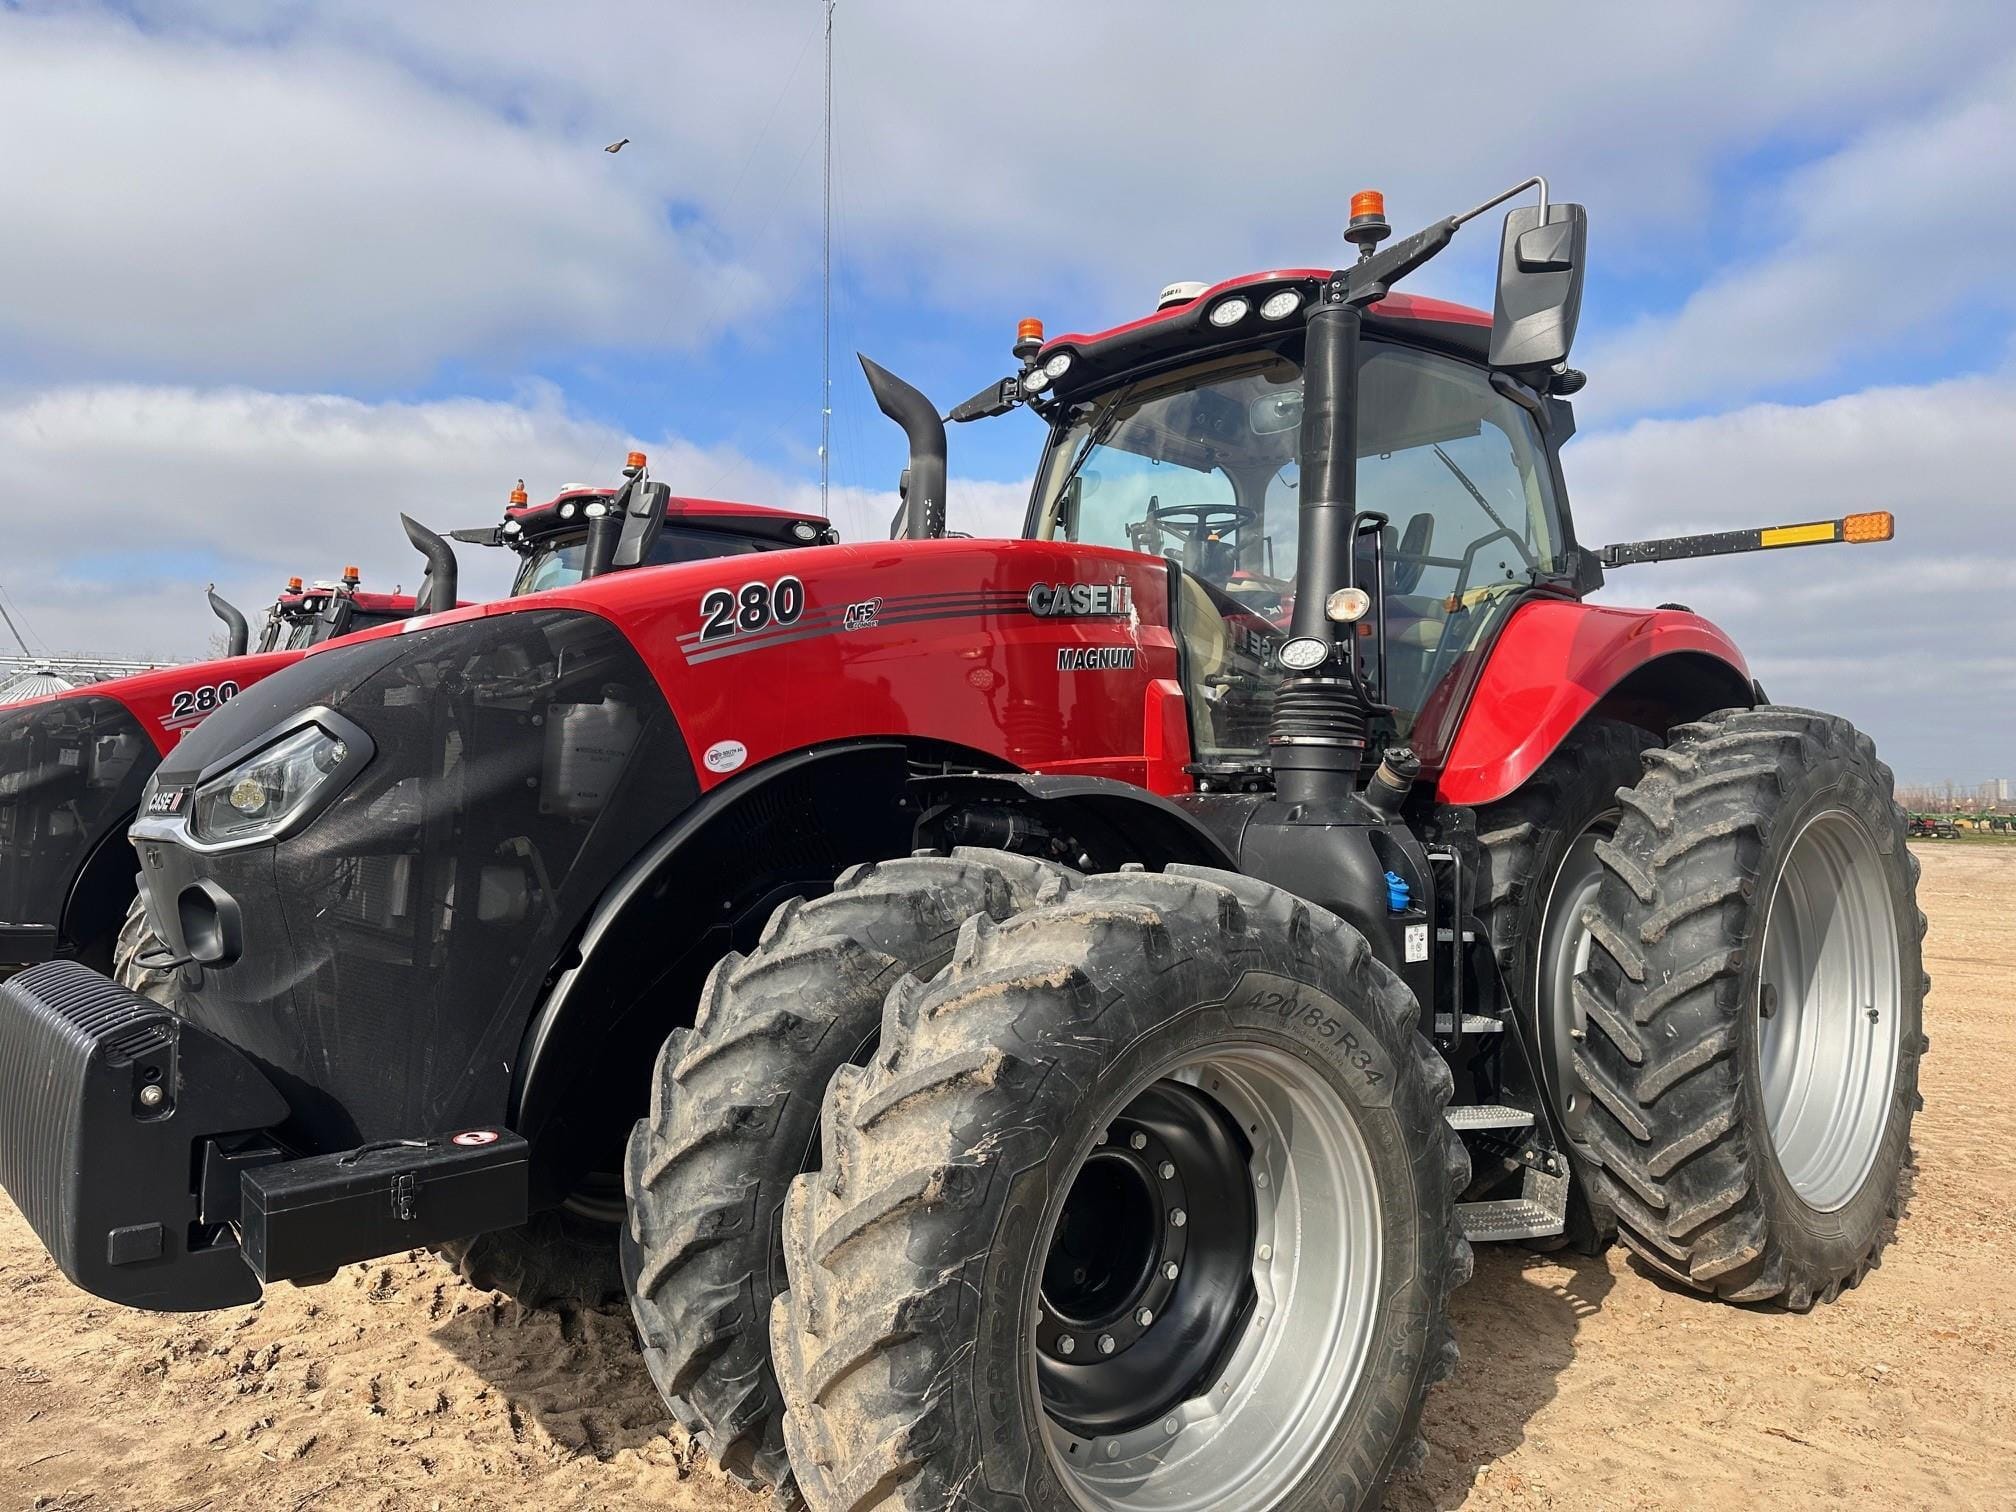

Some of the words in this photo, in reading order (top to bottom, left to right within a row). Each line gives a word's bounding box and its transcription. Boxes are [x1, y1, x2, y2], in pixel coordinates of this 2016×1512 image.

[700, 575, 805, 643] 280
[843, 602, 875, 623] AFS
[1057, 647, 1136, 671] MAGNUM
[171, 680, 240, 720] 280
